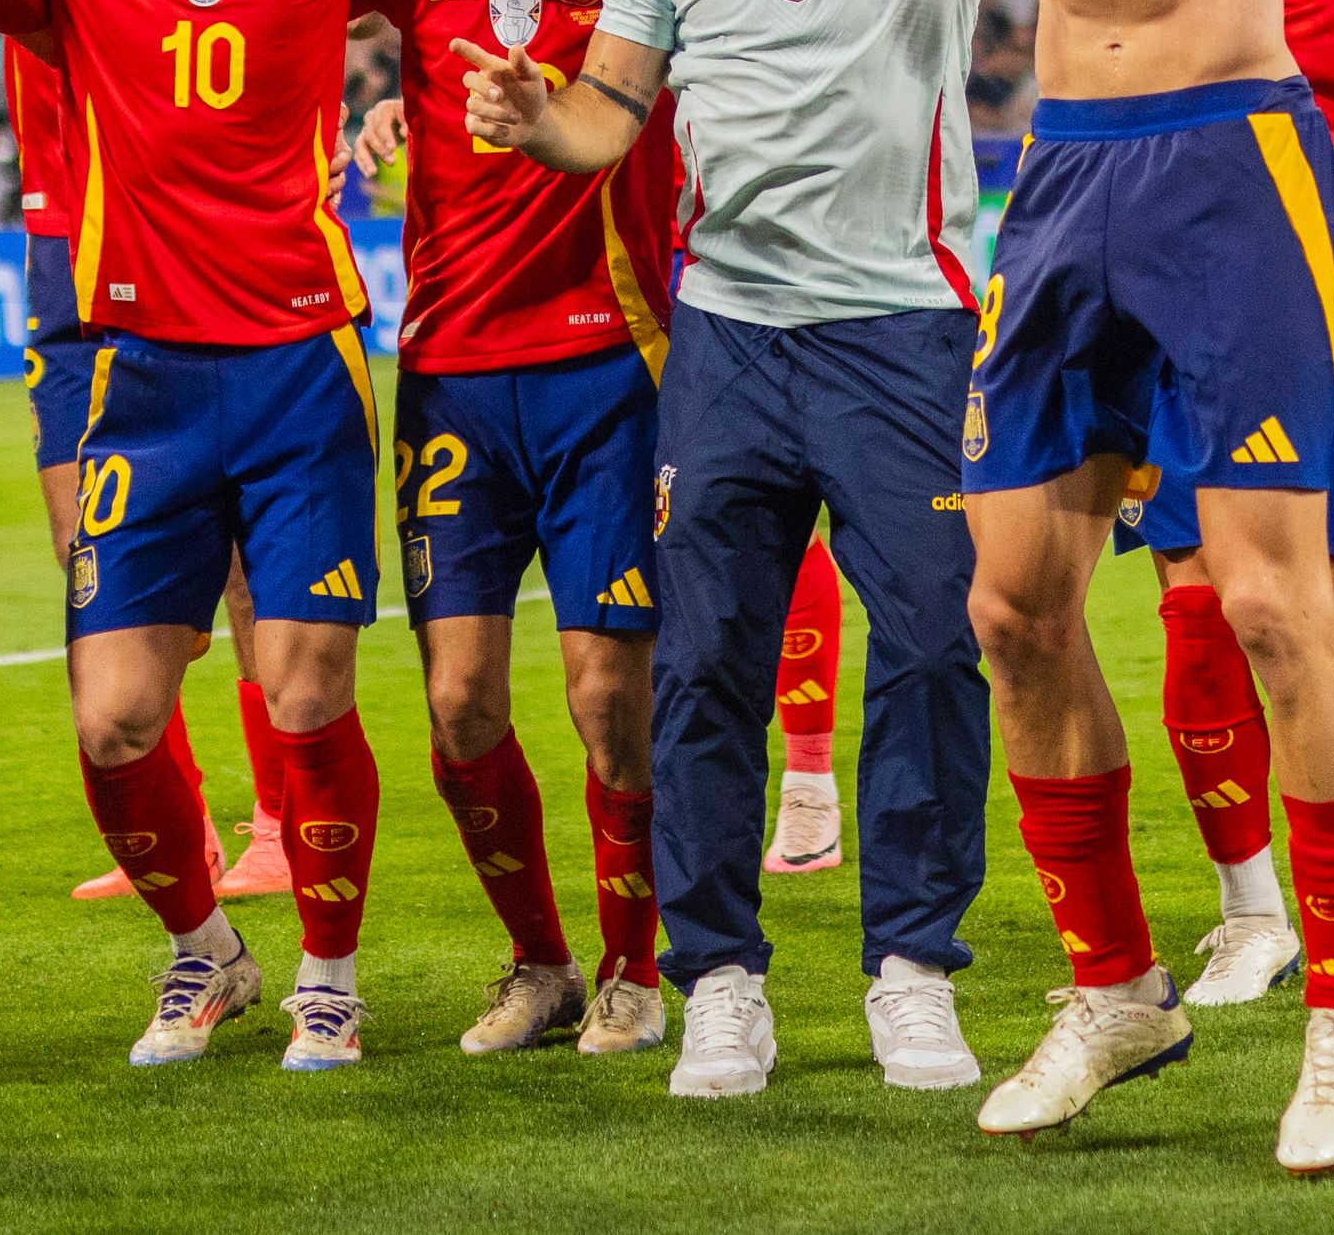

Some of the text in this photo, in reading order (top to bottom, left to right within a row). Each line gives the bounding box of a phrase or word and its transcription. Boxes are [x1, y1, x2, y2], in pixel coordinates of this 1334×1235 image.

[161, 20, 247, 110] 10
[291, 292, 330, 308] HEAT.RDY
[568, 313, 611, 325] HEAT.RDY
[396, 432, 468, 523] 22
